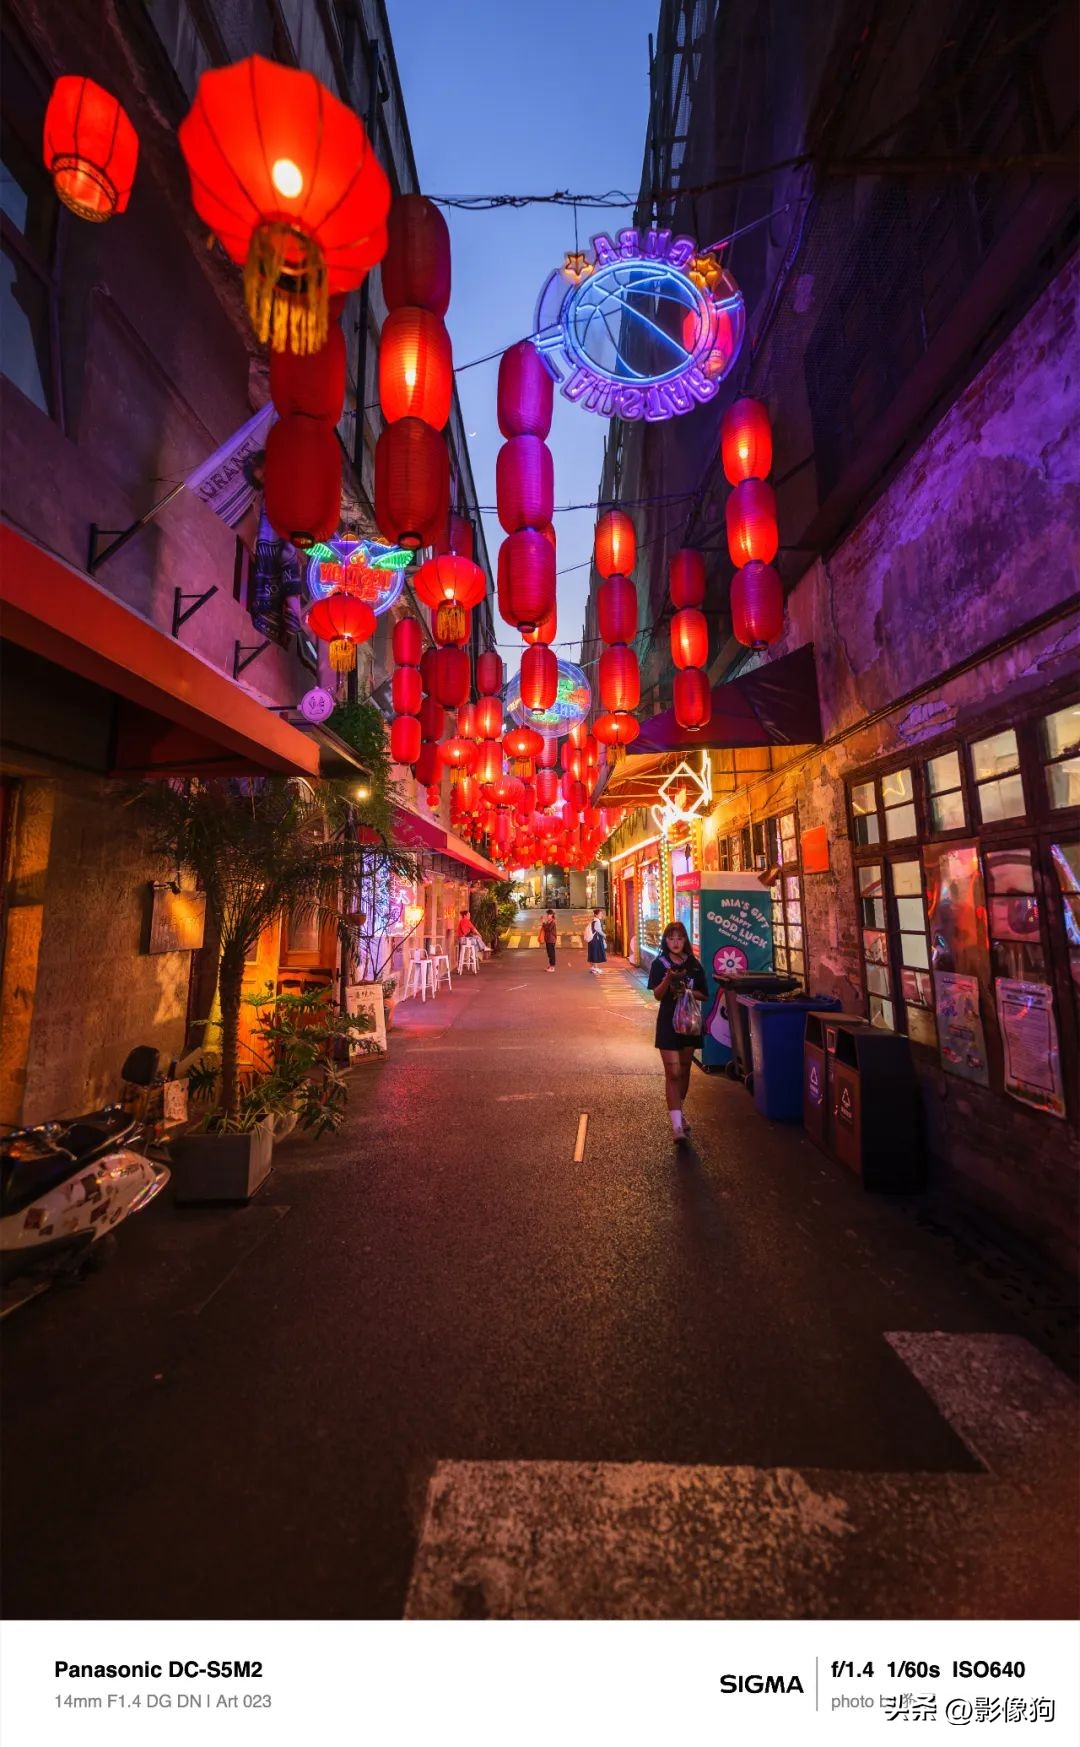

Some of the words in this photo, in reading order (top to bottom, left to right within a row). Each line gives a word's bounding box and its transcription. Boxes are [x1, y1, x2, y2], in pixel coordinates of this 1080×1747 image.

[721, 899, 749, 910] MIA'S
[751, 908, 769, 928] GIFT
[707, 912, 737, 932] GOOD
[739, 928, 767, 948] LUCK
